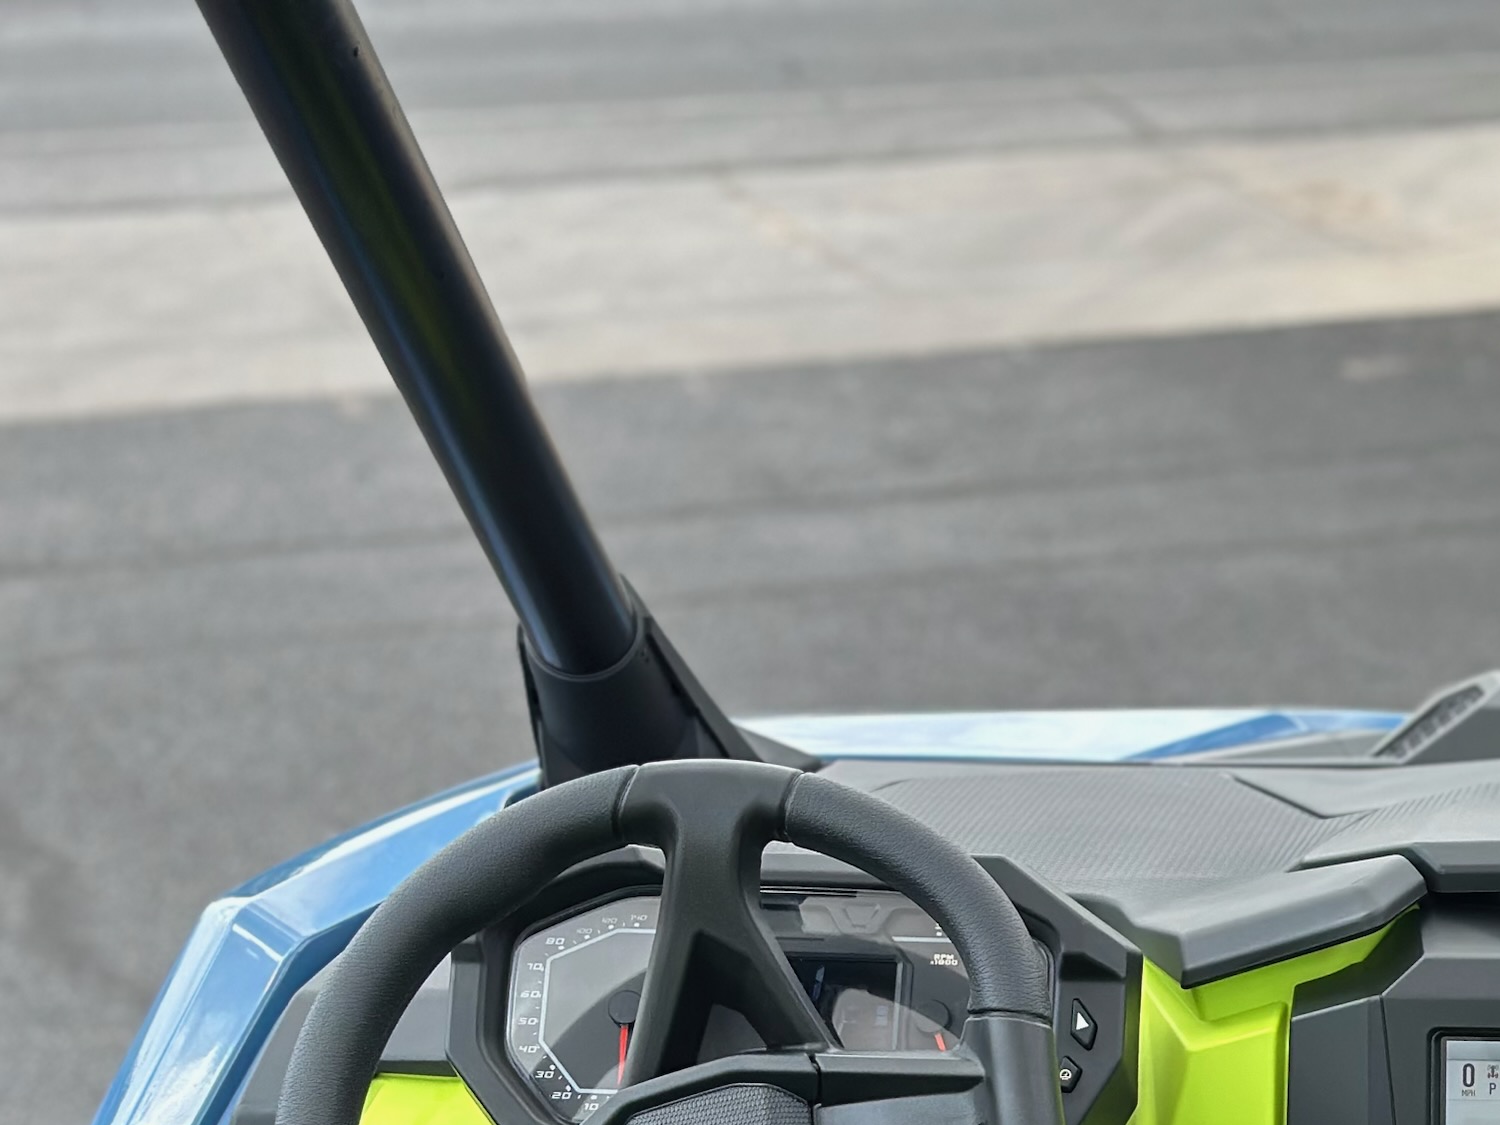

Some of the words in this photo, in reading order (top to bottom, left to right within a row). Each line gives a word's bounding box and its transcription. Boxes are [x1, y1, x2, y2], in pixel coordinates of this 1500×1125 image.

[545, 937, 565, 945] 80
[518, 1017, 538, 1025] 50
[519, 1045, 538, 1053] 40
[535, 1070, 554, 1079] 30
[1462, 1063, 1475, 1088] 0
[1461, 1089, 1476, 1097] MPH
[1489, 1082, 1497, 1095] P
[551, 1091, 572, 1100] 20
[584, 1102, 599, 1111] 10
